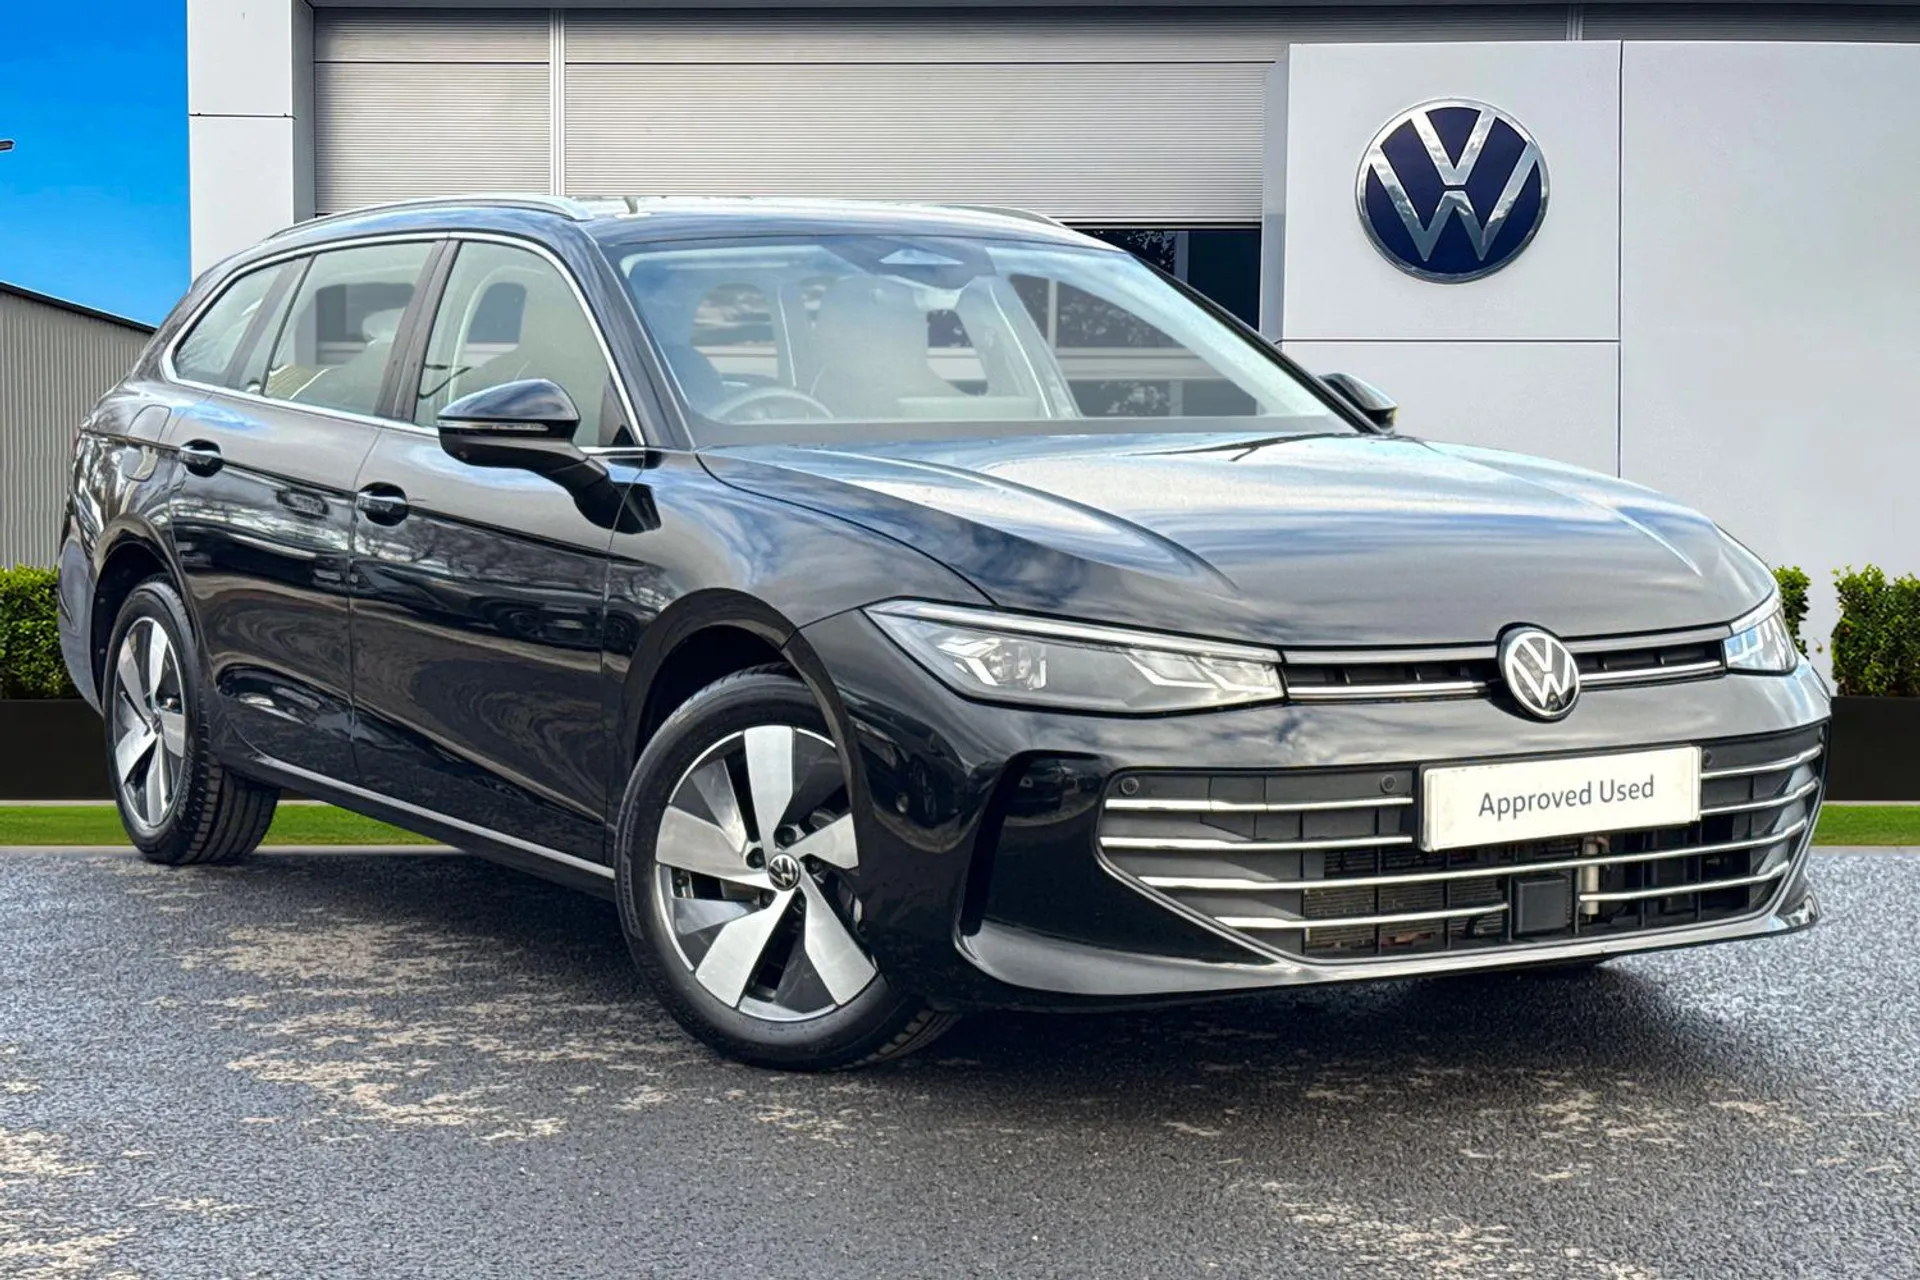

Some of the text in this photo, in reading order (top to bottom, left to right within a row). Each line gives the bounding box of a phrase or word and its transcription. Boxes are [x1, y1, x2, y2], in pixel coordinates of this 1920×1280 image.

[1362, 104, 1542, 262] VW
[1508, 634, 1574, 708] VW
[1478, 774, 1655, 821] Approved Used
